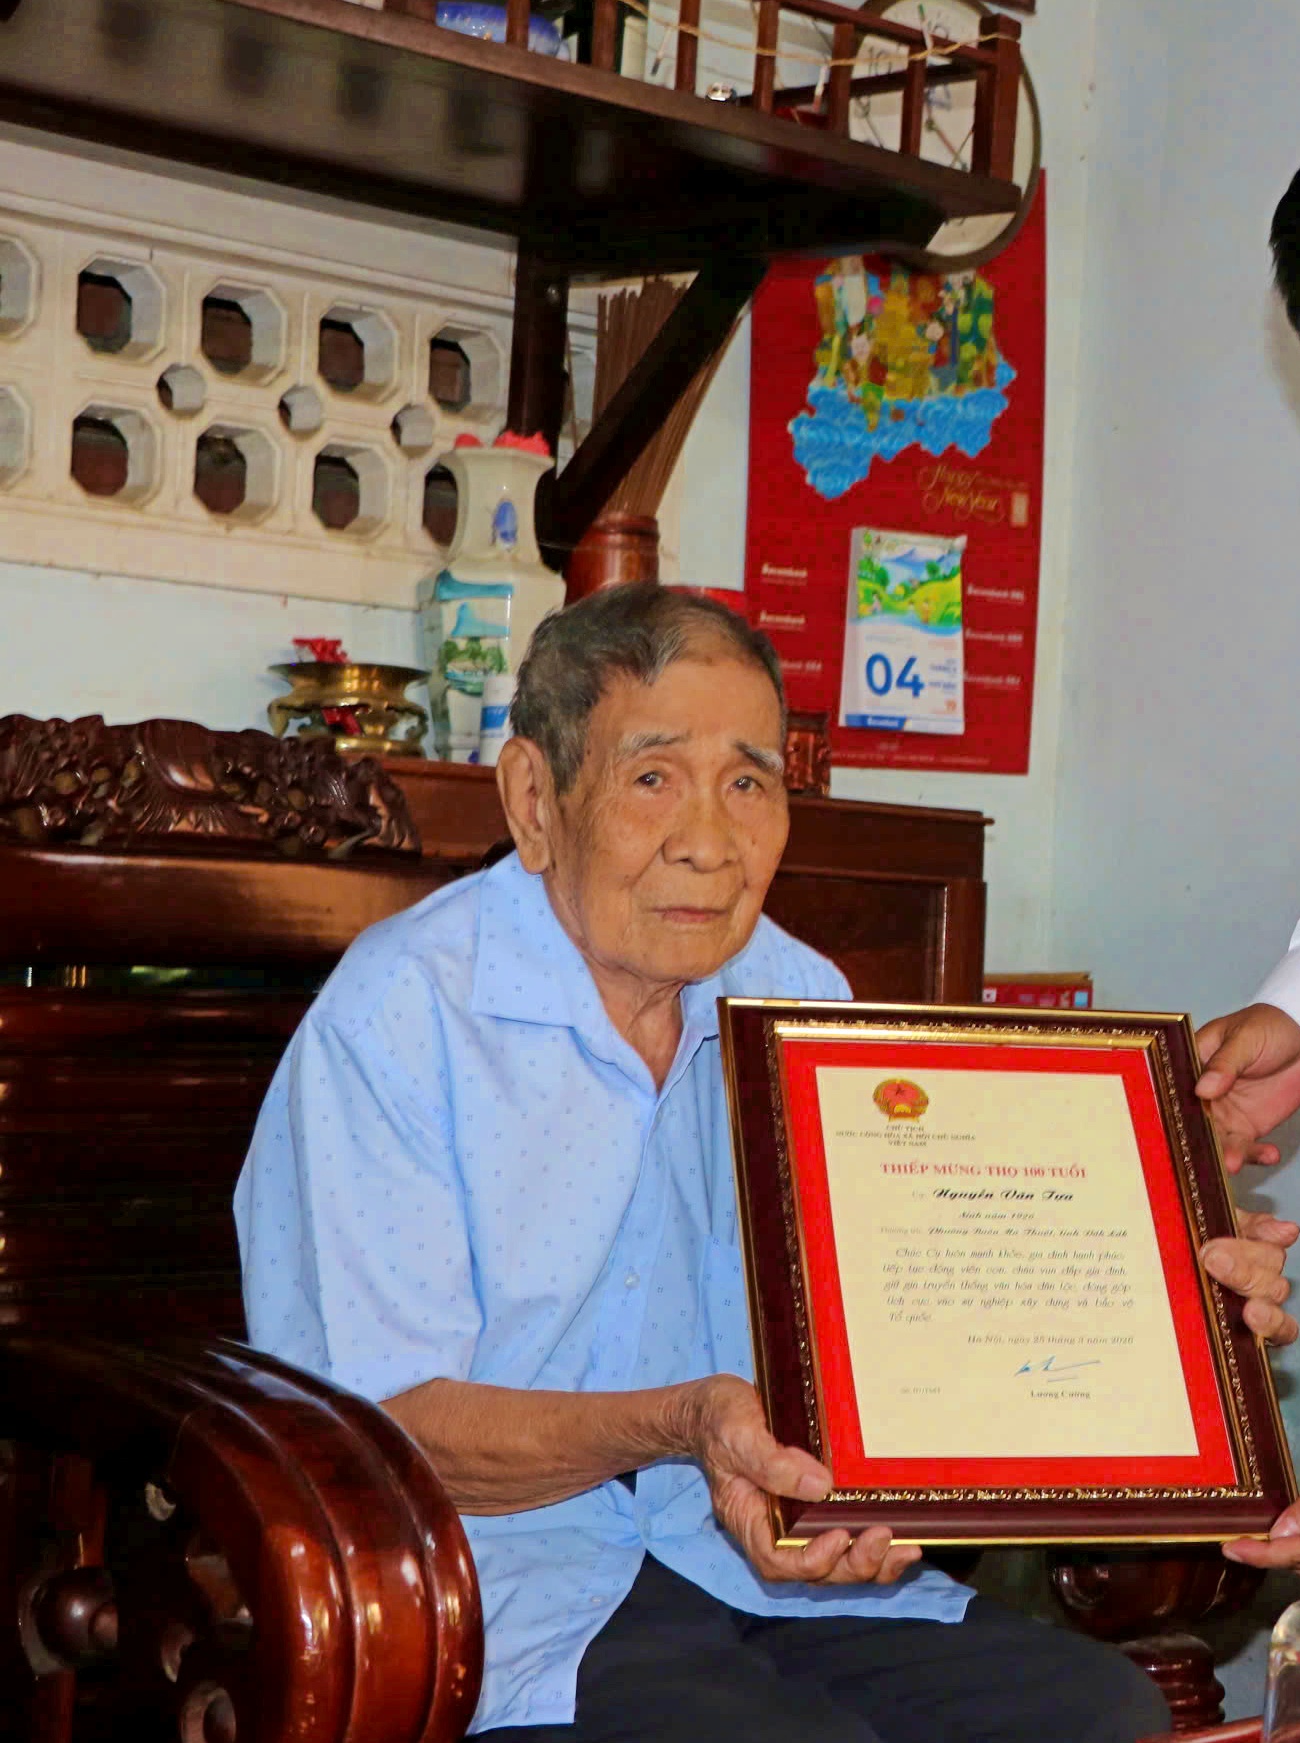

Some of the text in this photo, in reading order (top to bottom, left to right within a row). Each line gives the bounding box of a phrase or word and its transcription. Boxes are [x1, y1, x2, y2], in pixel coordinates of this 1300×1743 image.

[865, 652, 925, 698] 04
[880, 1159, 929, 1175] THIẾP
[933, 1162, 981, 1176] MỪNG
[984, 1164, 1018, 1178] THỌ
[1023, 1165, 1045, 1177] 100
[1030, 1389, 1059, 1400] Lương
